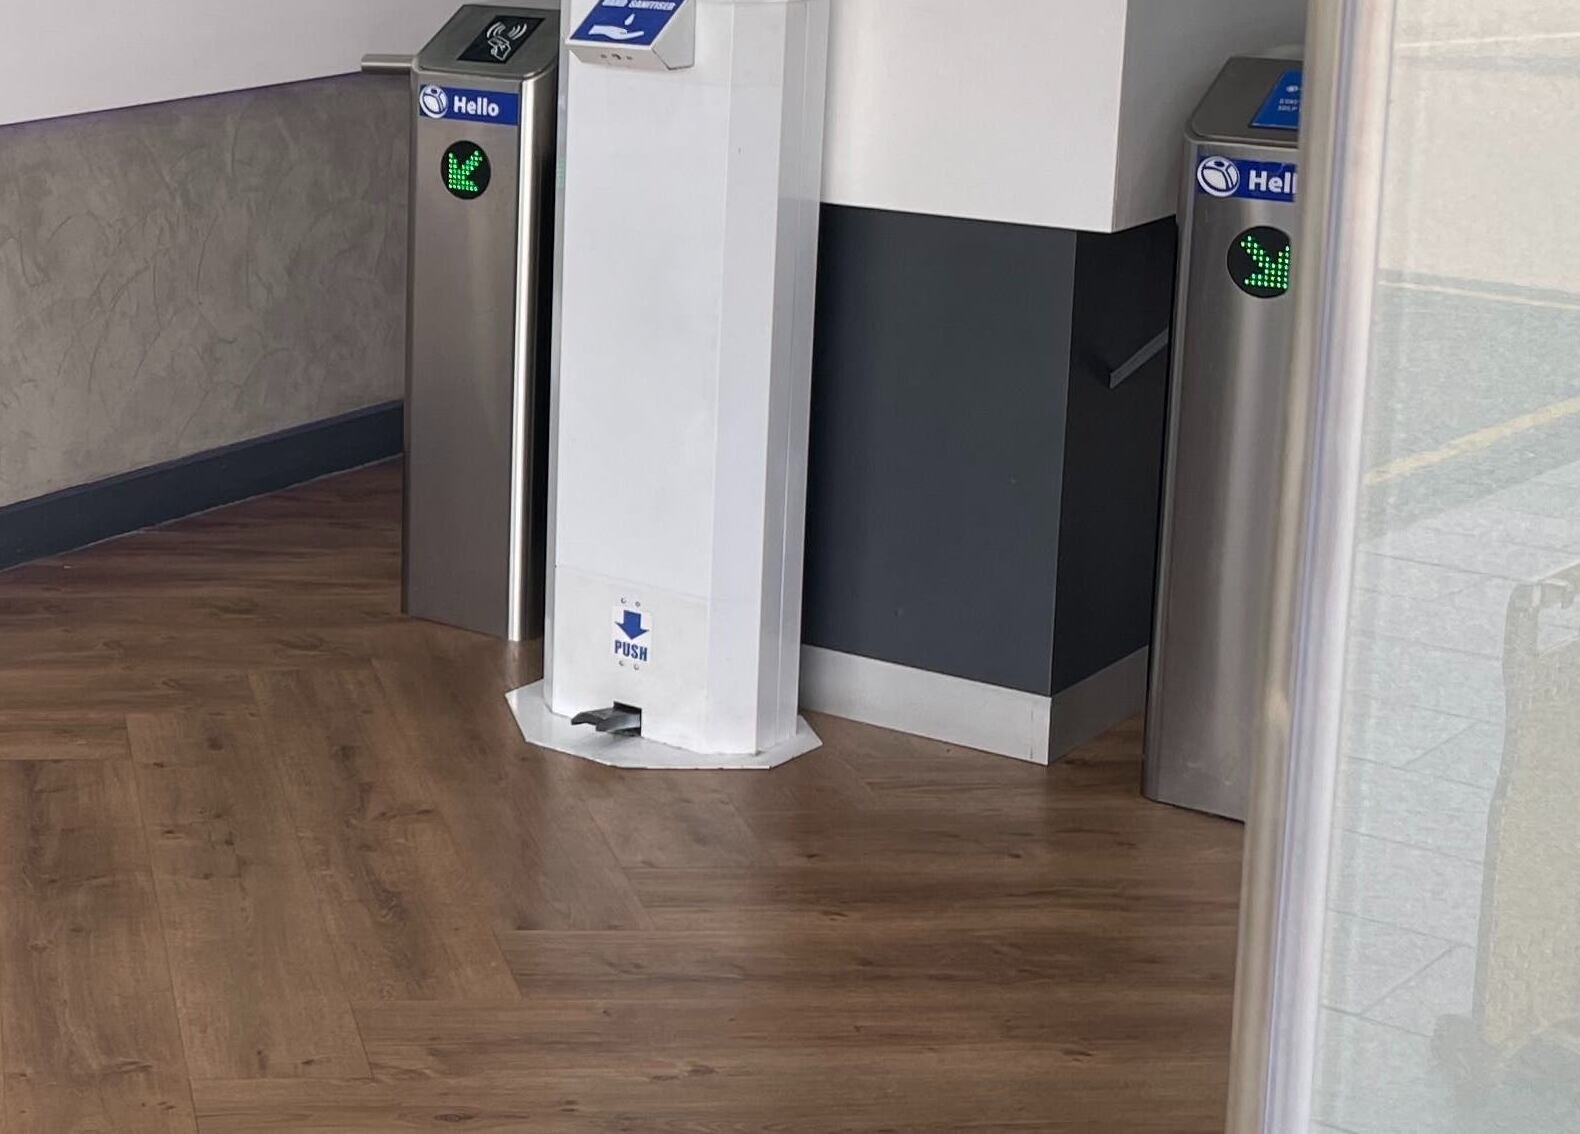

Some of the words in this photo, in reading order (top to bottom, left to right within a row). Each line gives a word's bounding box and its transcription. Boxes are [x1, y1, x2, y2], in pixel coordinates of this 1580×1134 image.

[453, 95, 500, 117] Hello
[1248, 169, 1297, 194] Hell
[614, 639, 648, 662] PUSH
